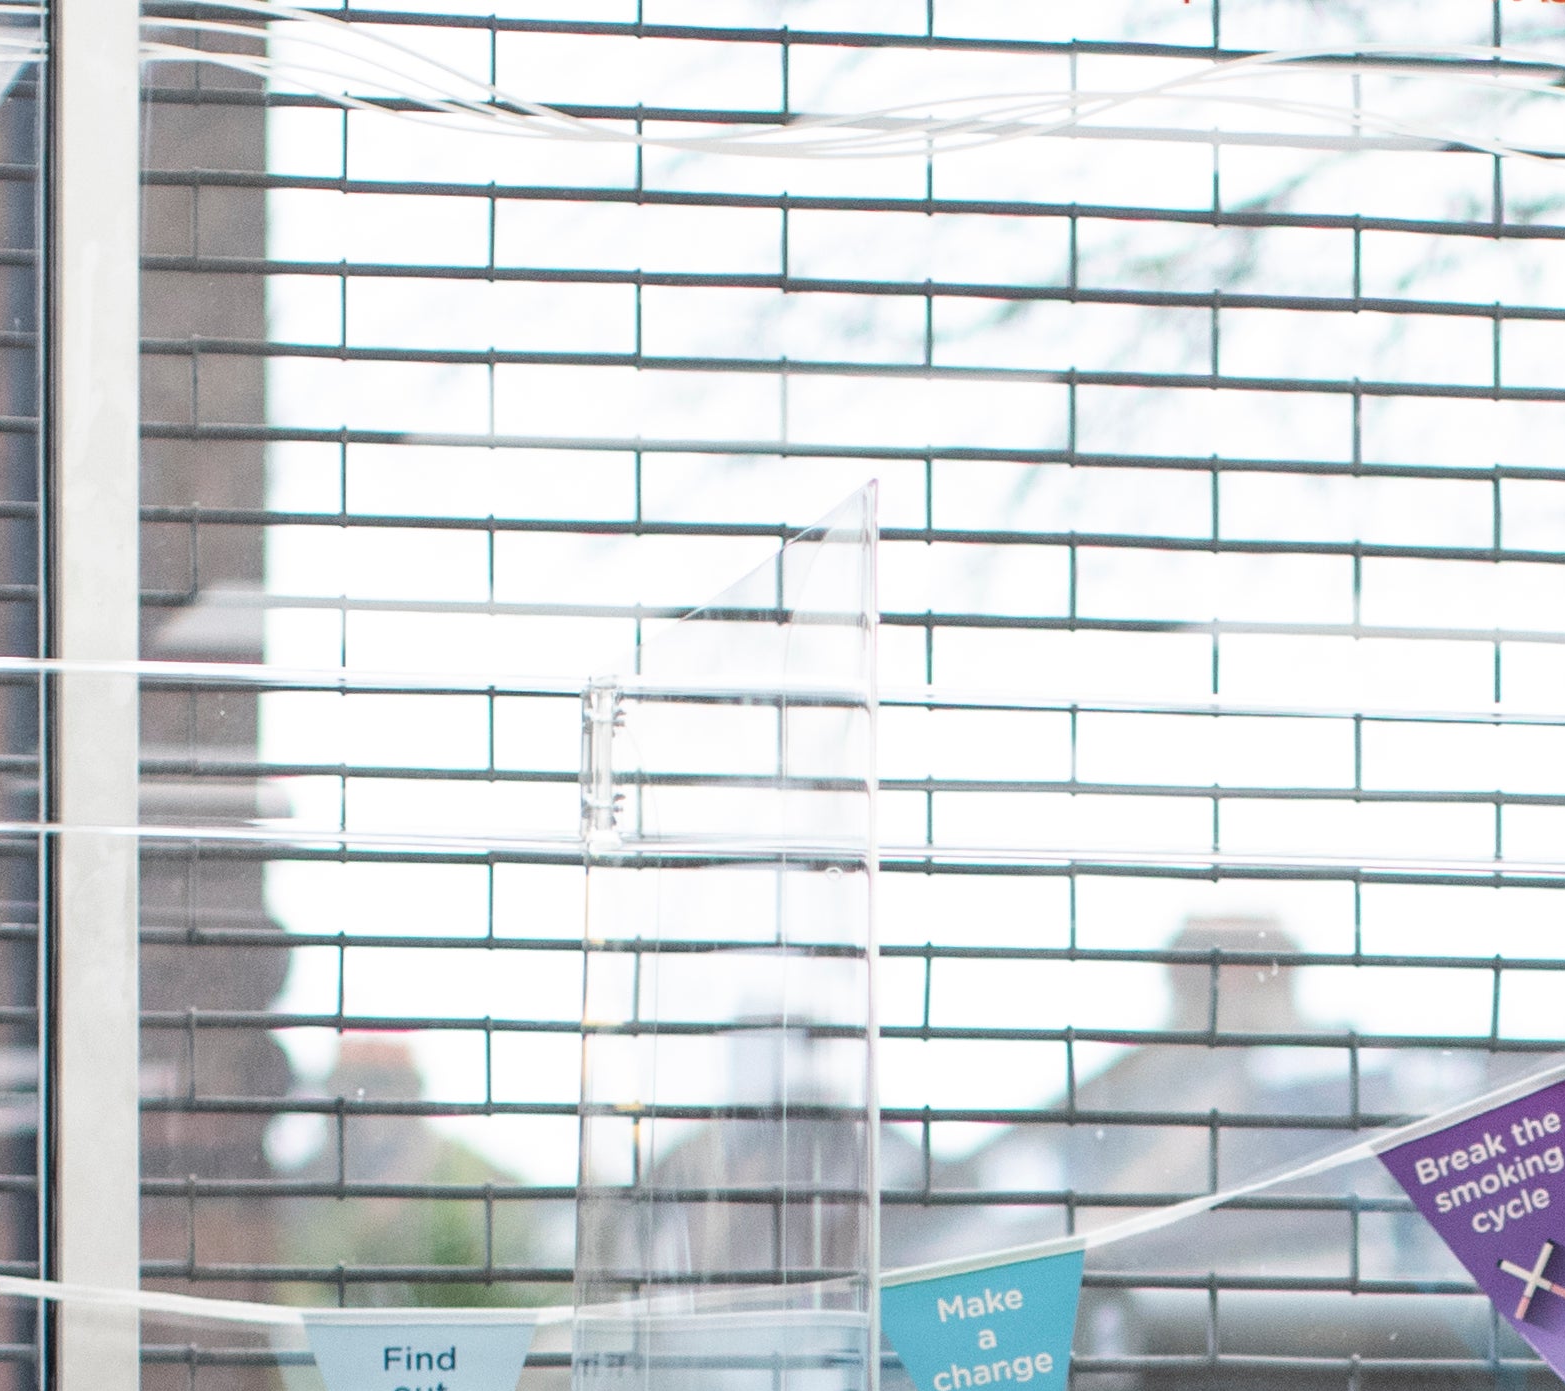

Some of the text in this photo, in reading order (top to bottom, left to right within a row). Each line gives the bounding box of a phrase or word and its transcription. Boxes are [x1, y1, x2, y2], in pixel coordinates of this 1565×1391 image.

[1414, 1112, 1562, 1185] Break the
[1435, 1147, 1565, 1213] smoking
[1471, 1188, 1550, 1233] cycle
[937, 1288, 1024, 1322] Make
[383, 1345, 456, 1372] Find
[978, 1329, 997, 1350] a
[933, 1352, 1054, 1391] change
